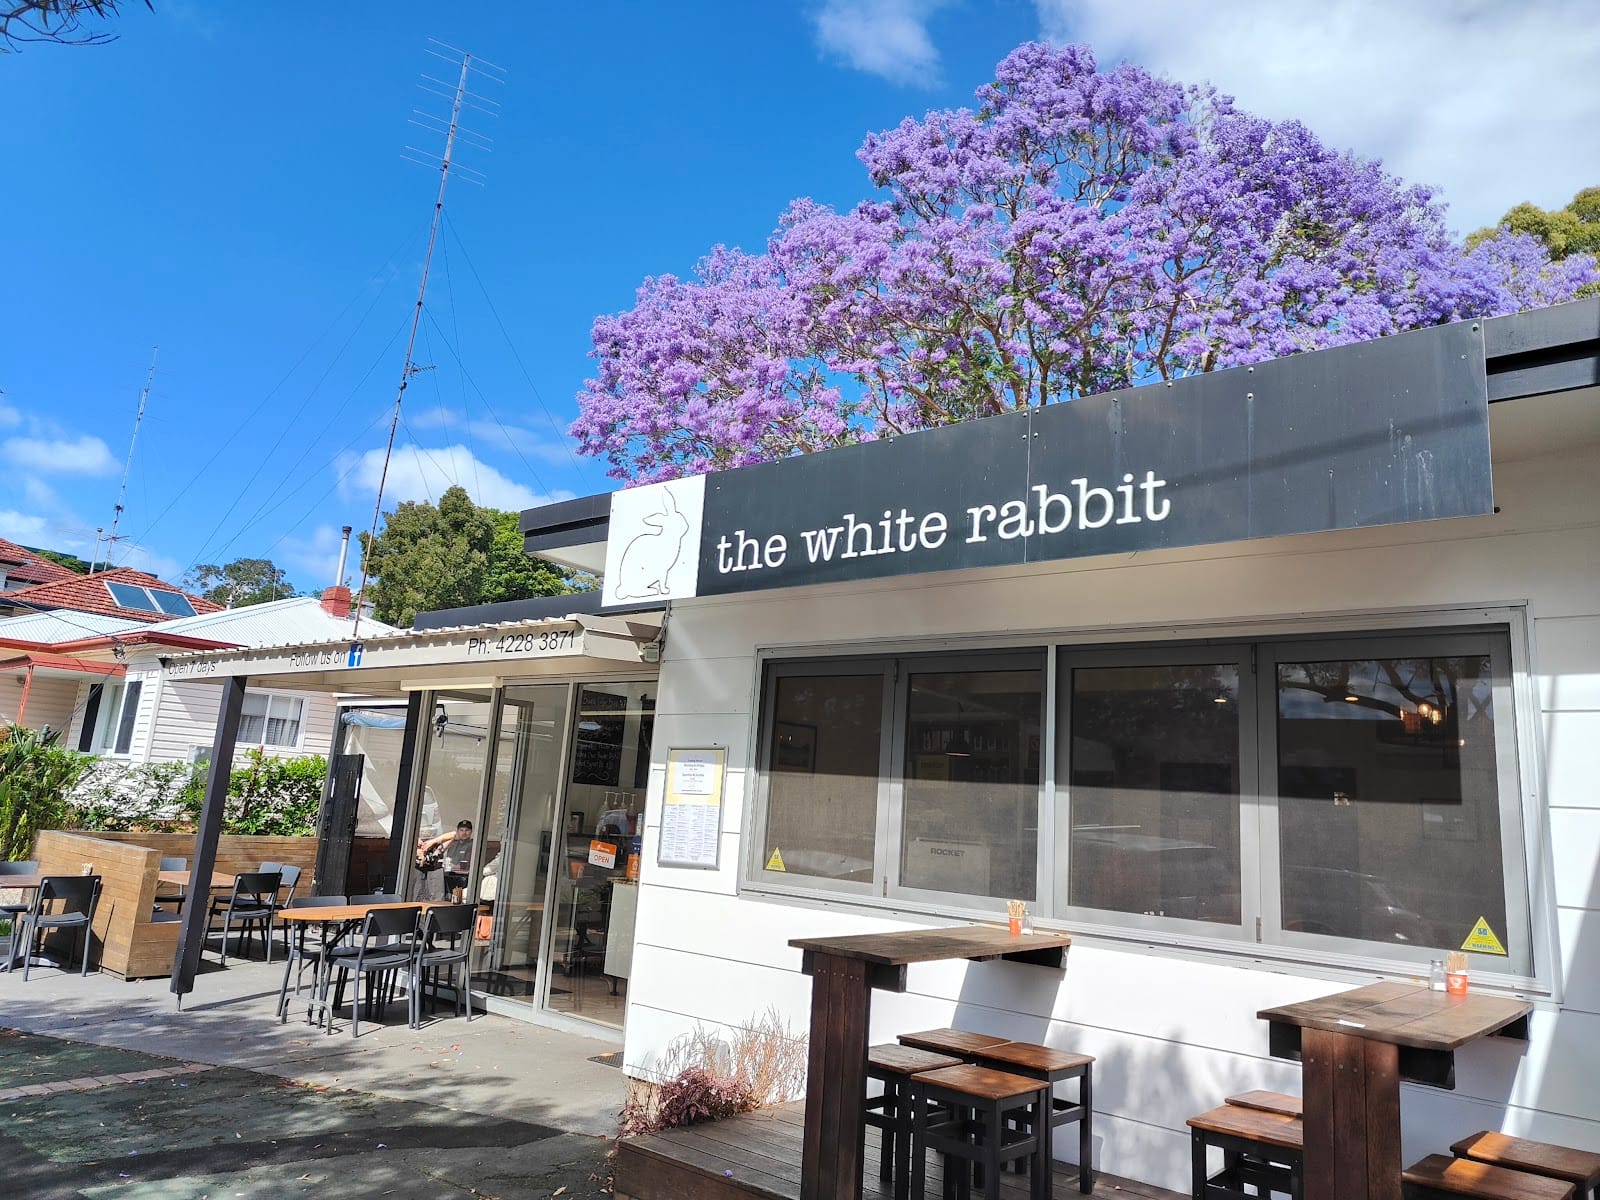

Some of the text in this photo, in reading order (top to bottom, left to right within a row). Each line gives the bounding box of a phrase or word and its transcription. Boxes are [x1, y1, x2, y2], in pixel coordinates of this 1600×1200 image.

[716, 470, 1171, 574] the white rabbit
[468, 630, 575, 655] Ph: 4228 3871
[289, 652, 318, 668] Follow
[320, 653, 331, 665] us
[333, 651, 346, 664] on
[168, 662, 190, 678] Open
[196, 661, 216, 676] days
[593, 854, 610, 864] OPEN
